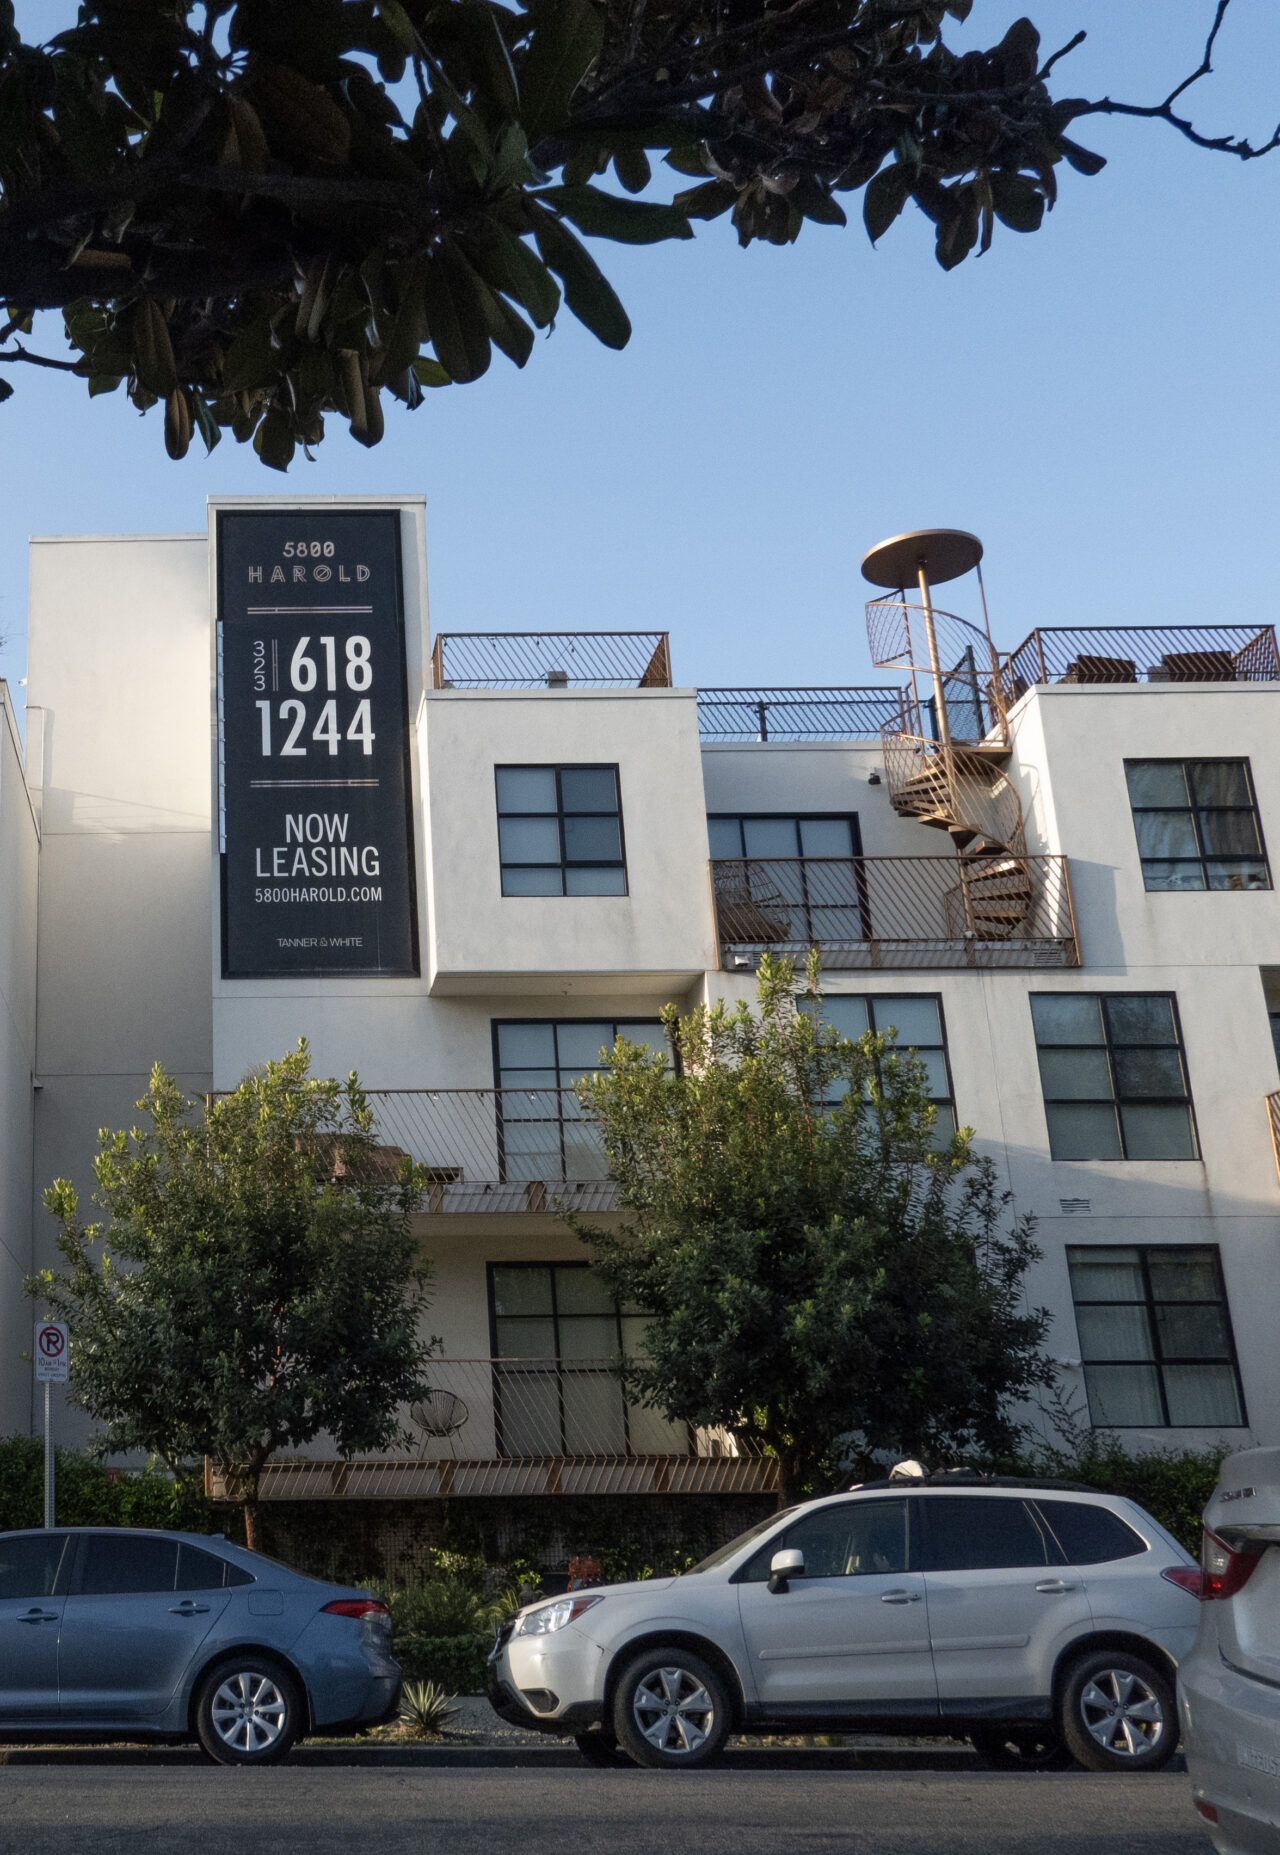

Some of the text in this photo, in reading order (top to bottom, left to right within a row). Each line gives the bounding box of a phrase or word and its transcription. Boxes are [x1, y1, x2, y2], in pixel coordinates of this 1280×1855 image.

[283, 541, 335, 558] 5800
[248, 564, 370, 583] HAROLD
[290, 635, 373, 692] 618
[255, 699, 376, 756] 1244
[285, 813, 349, 843] NOW
[256, 846, 380, 877] LEASING
[255, 887, 382, 903] 5800HAROLD.COM
[277, 937, 318, 947] TANNER
[330, 937, 363, 947] WHITE
